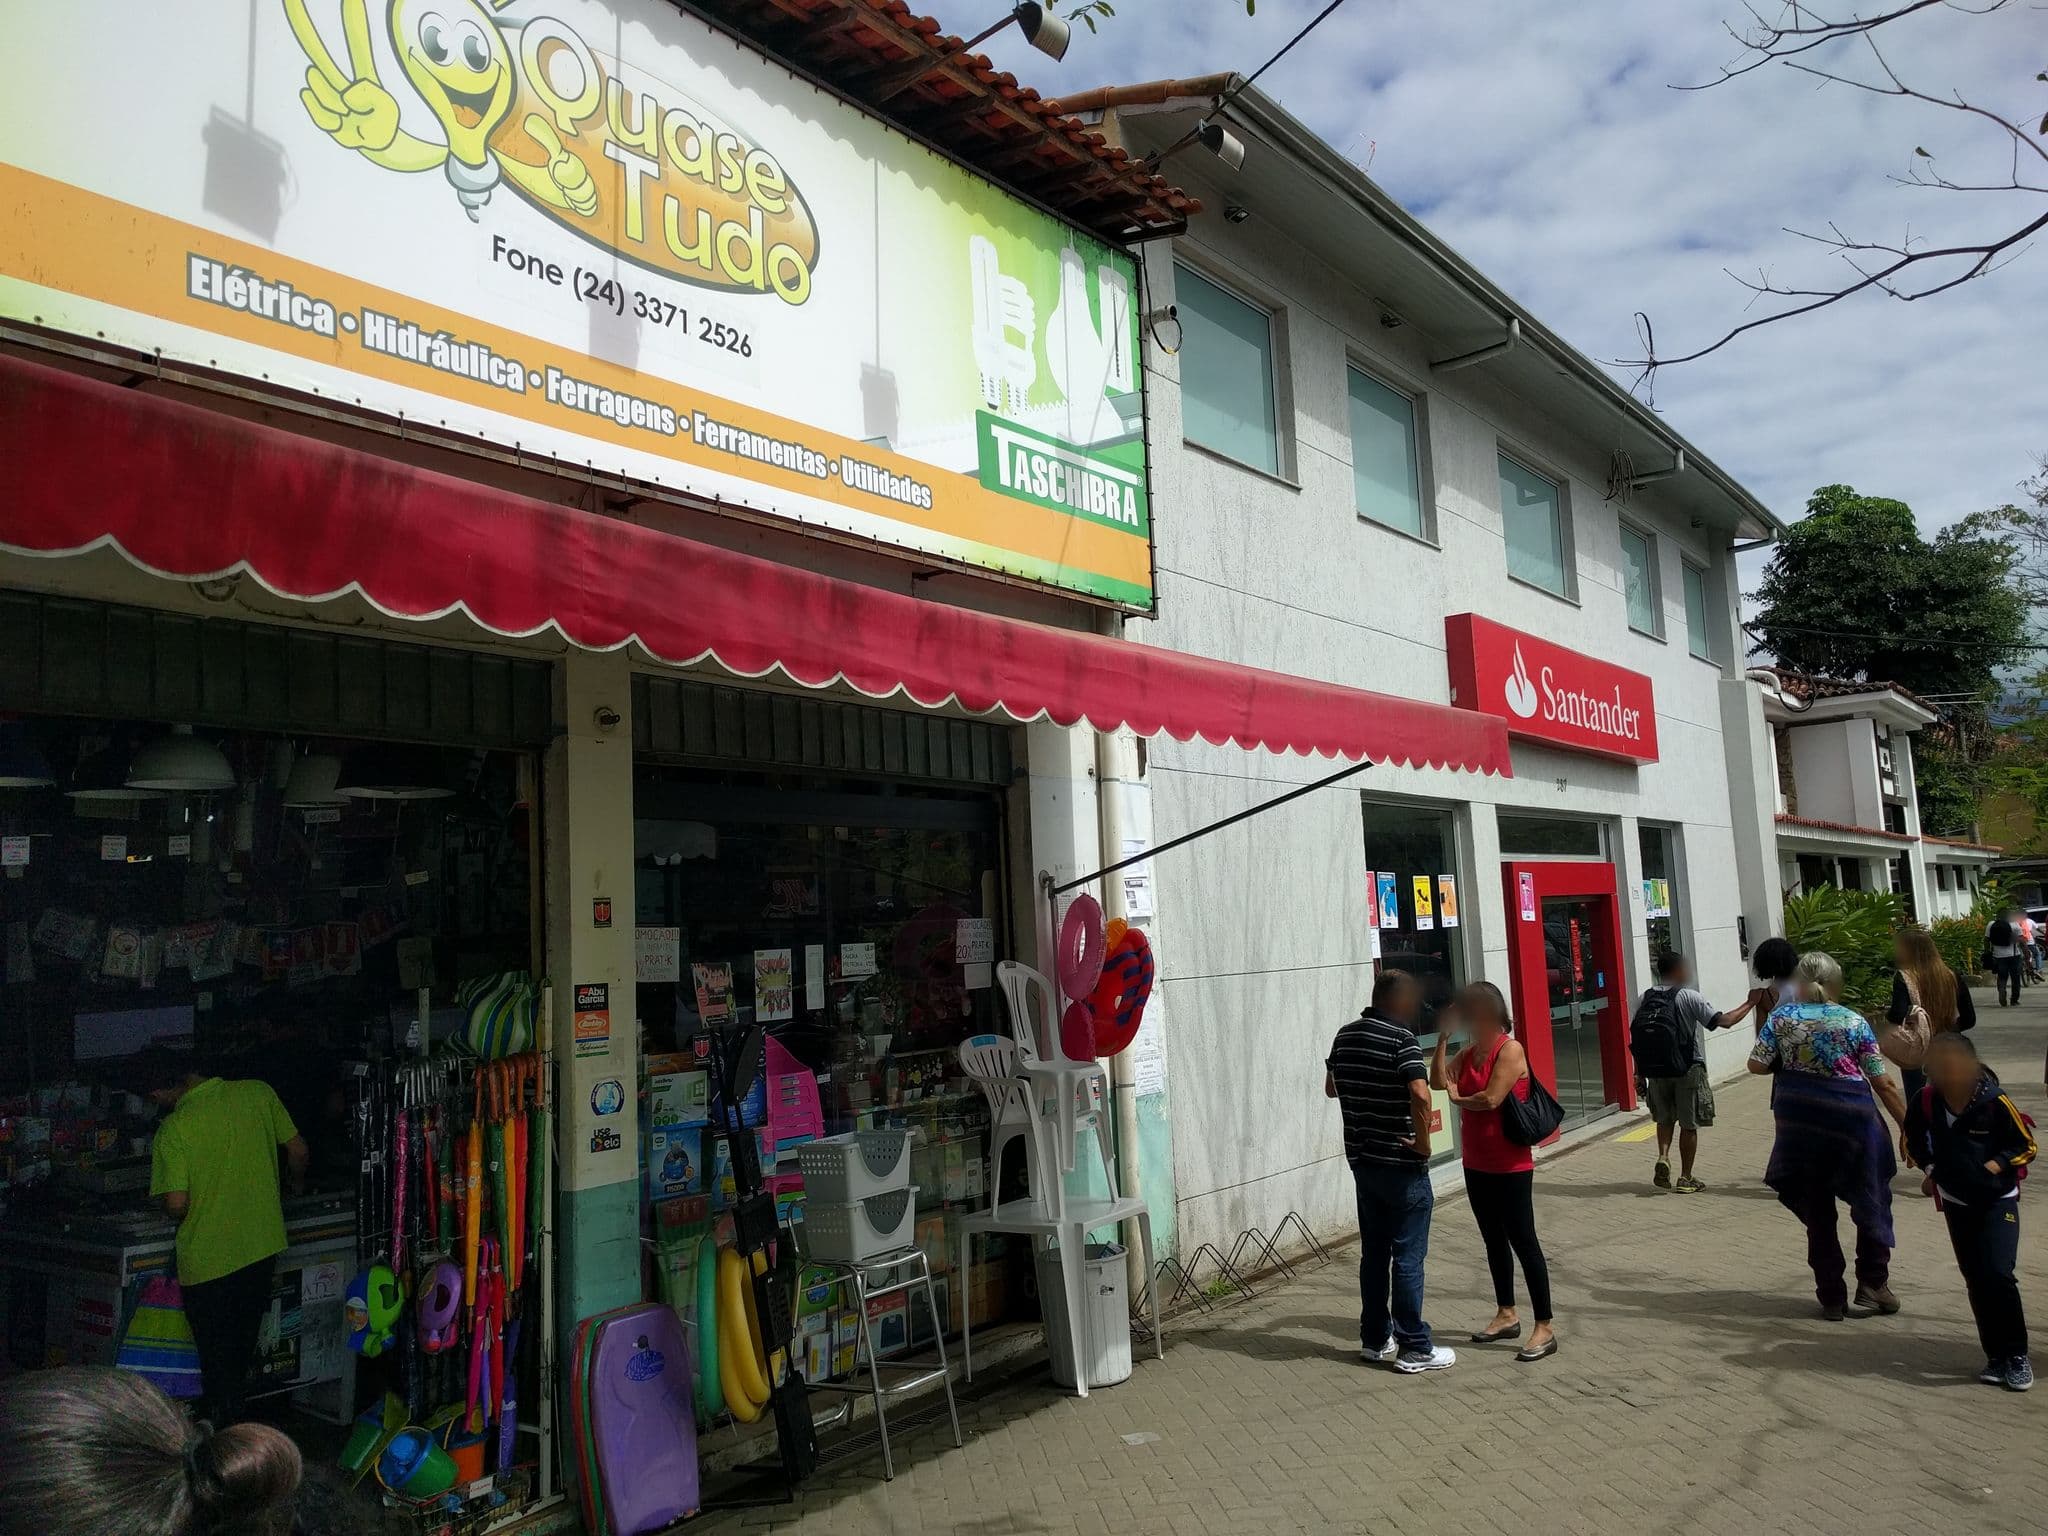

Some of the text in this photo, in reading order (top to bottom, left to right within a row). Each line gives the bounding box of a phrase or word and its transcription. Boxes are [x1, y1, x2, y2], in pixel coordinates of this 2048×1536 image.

[519, 15, 788, 214] Quase
[604, 139, 812, 307] Tudo
[492, 234, 753, 359] Fone (24) 3371 2526
[186, 251, 933, 510] Elétrica Hidráulica Ferragens Ferramentas Utilidades
[990, 423, 1140, 527] TASCHIBRA
[1540, 666, 1640, 741] Santander
